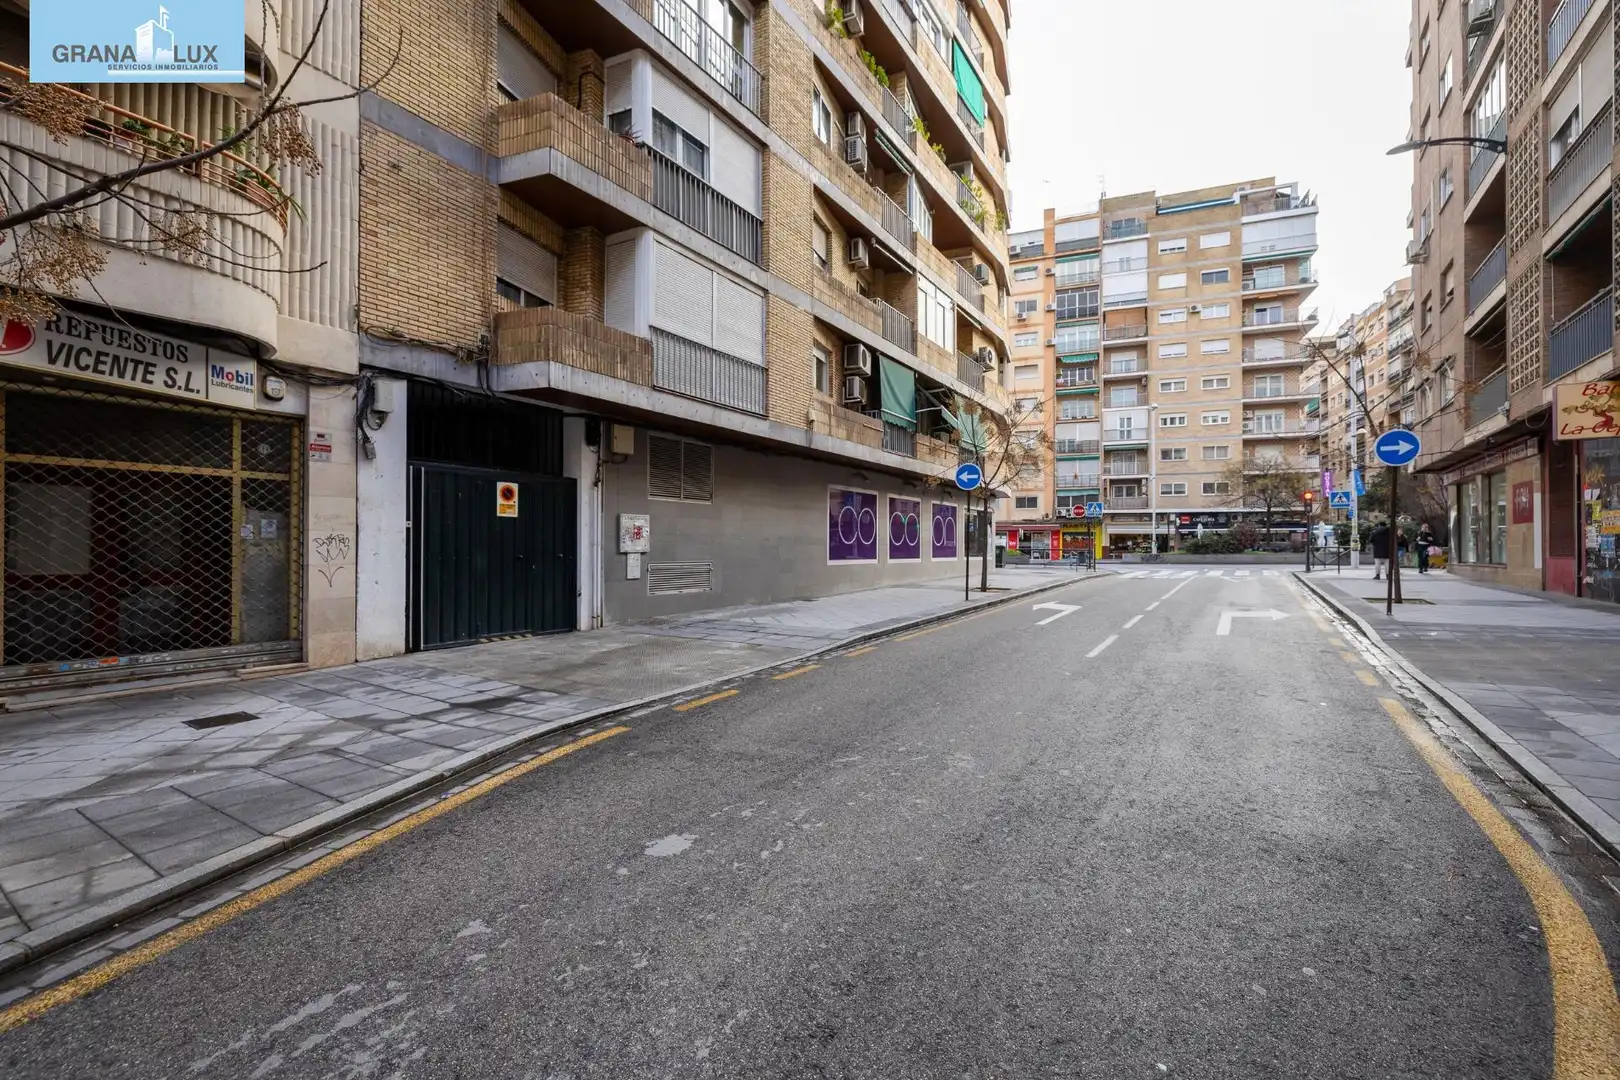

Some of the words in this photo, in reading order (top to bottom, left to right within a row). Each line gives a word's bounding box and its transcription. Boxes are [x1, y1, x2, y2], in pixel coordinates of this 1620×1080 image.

[44, 310, 189, 364] REPUESTOS
[46, 339, 157, 385] VICENTE
[163, 366, 201, 395] S.L.
[211, 363, 254, 386] Mobil
[211, 378, 254, 394] Lubricantes
